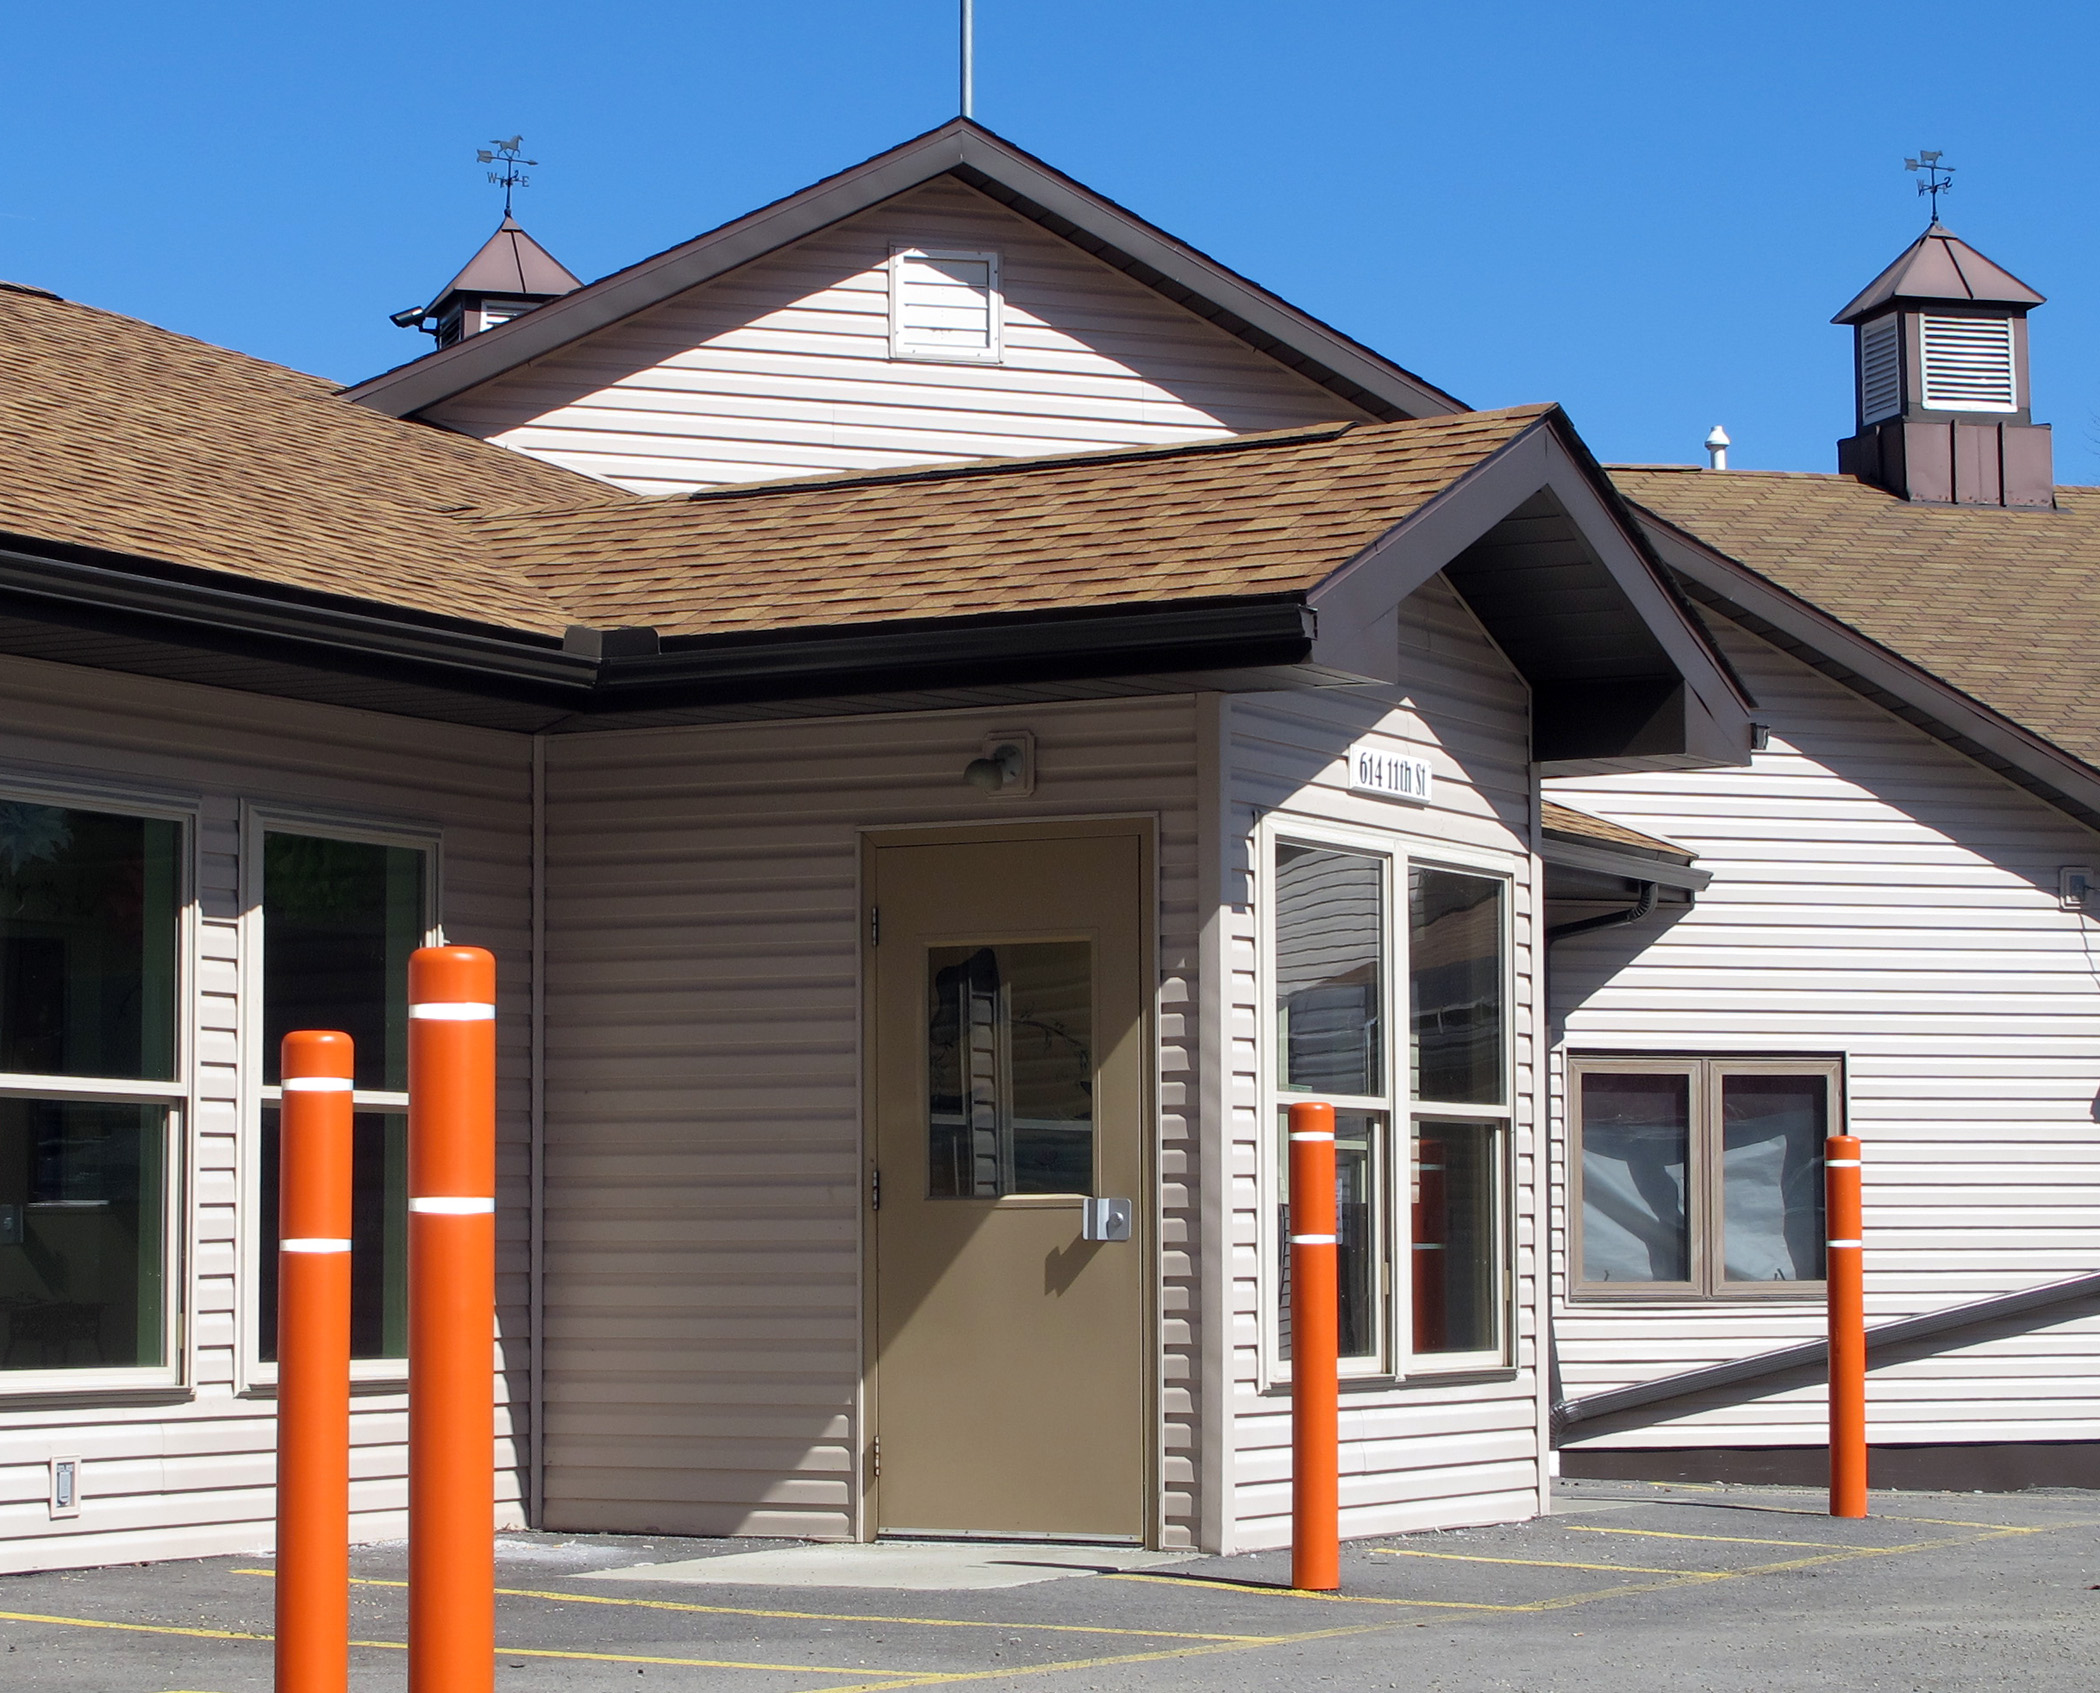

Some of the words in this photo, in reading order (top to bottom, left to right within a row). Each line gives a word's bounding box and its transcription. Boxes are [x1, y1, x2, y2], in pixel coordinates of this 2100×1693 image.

[487, 171, 497, 184] W
[522, 176, 530, 187] E
[1360, 752, 1383, 787] 614
[1387, 758, 1412, 793] 11th
[1416, 763, 1426, 796] St
